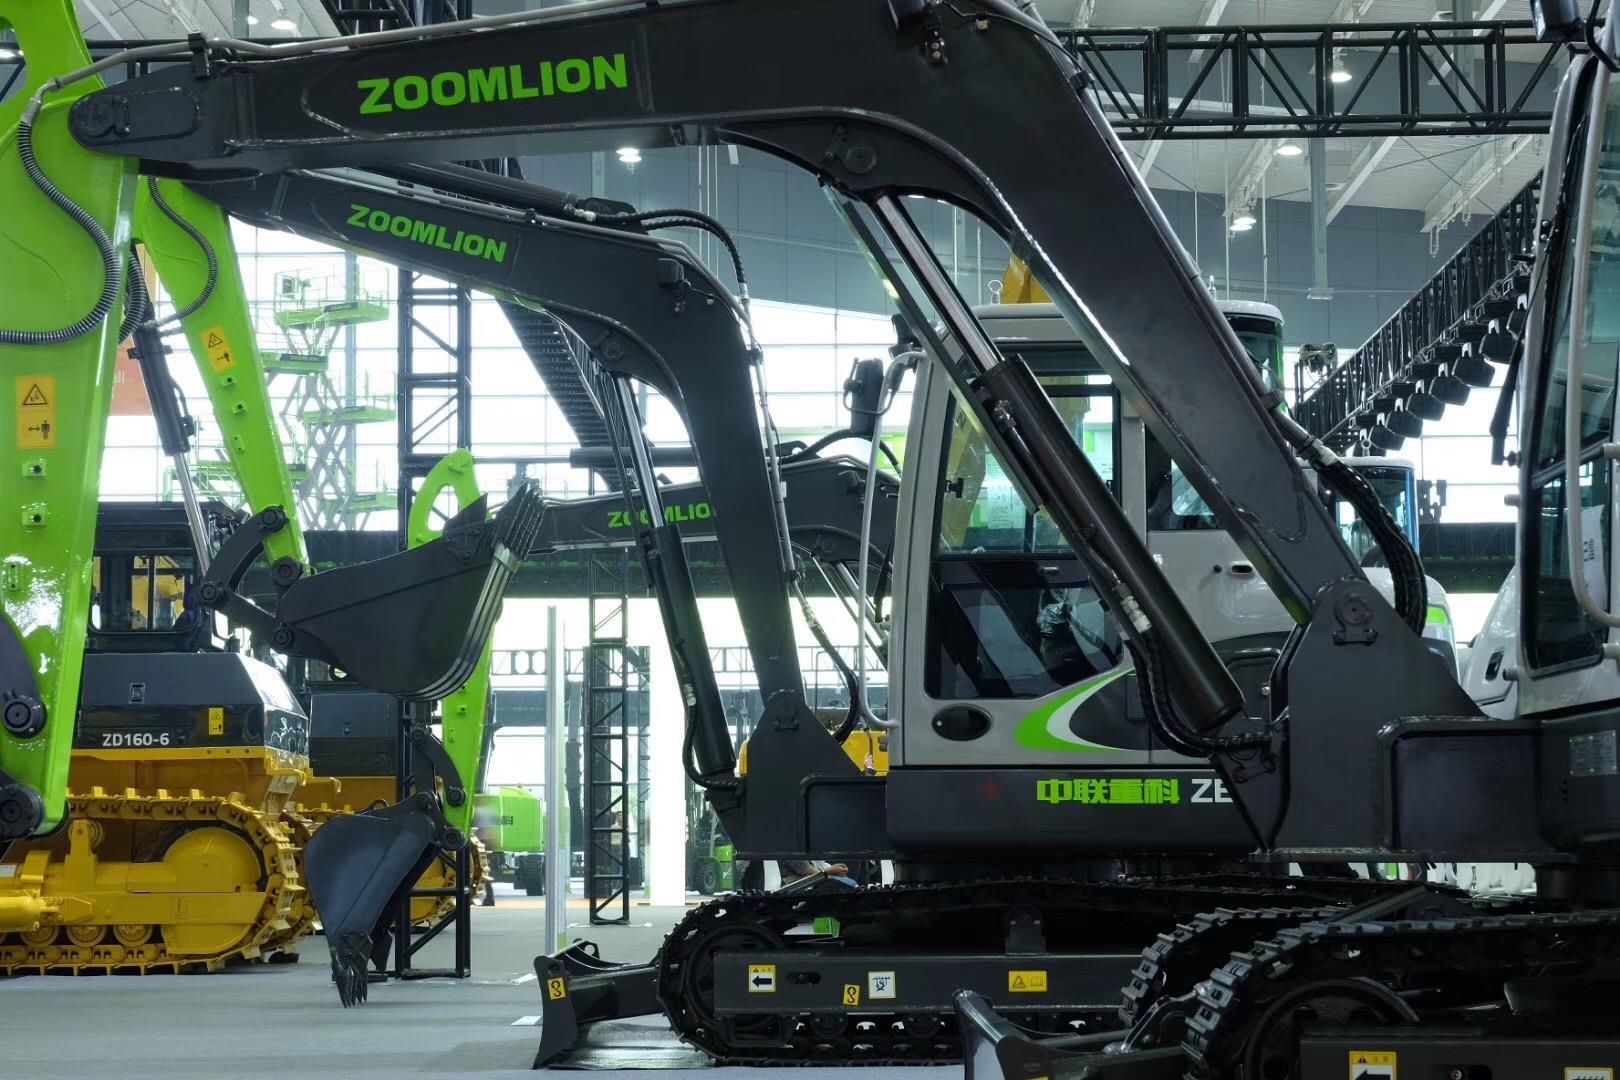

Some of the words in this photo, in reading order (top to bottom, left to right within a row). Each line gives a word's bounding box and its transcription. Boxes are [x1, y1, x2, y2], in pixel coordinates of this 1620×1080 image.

[357, 53, 628, 114] ZOOMLION
[347, 203, 508, 263] ZOOMLION
[102, 732, 170, 747] ZD160-6
[1036, 778, 1180, 804] 中联重科
